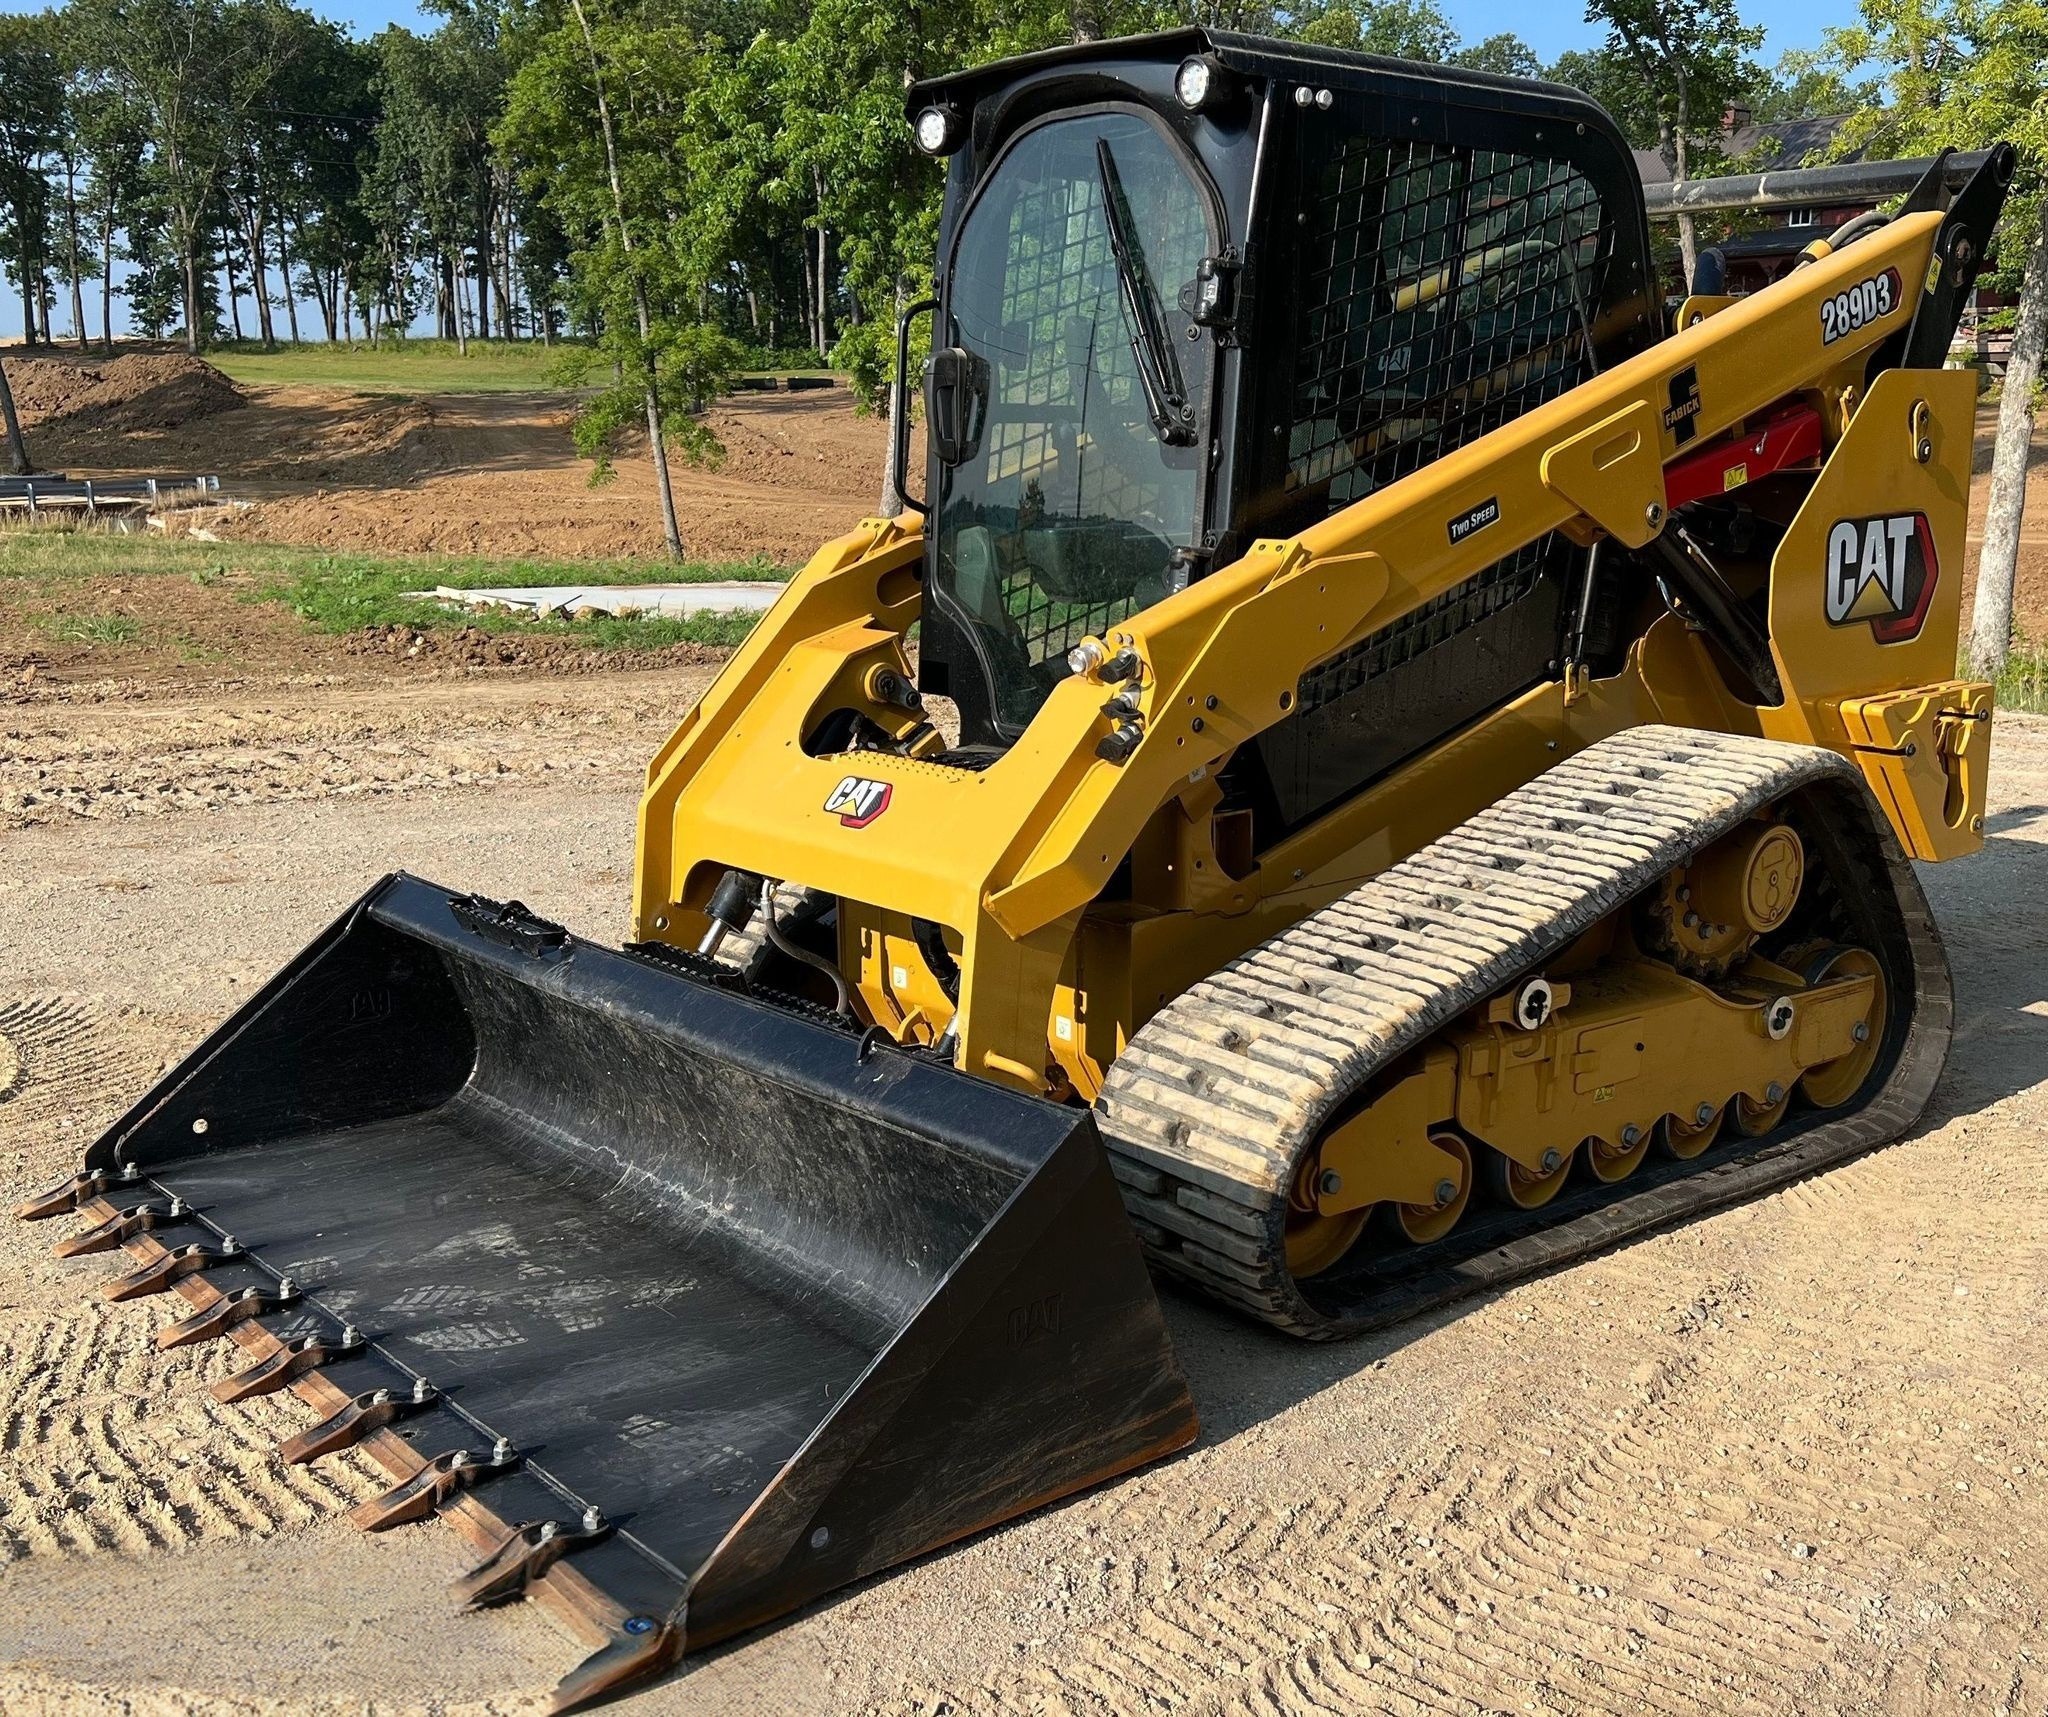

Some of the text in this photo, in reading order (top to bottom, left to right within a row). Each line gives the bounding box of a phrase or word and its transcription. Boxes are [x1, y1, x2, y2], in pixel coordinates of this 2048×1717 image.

[1822, 273, 1892, 343] 289D3
[1665, 397, 1700, 427] FABICK
[1826, 516, 1915, 621] CAT
[824, 776, 887, 817] CAT
